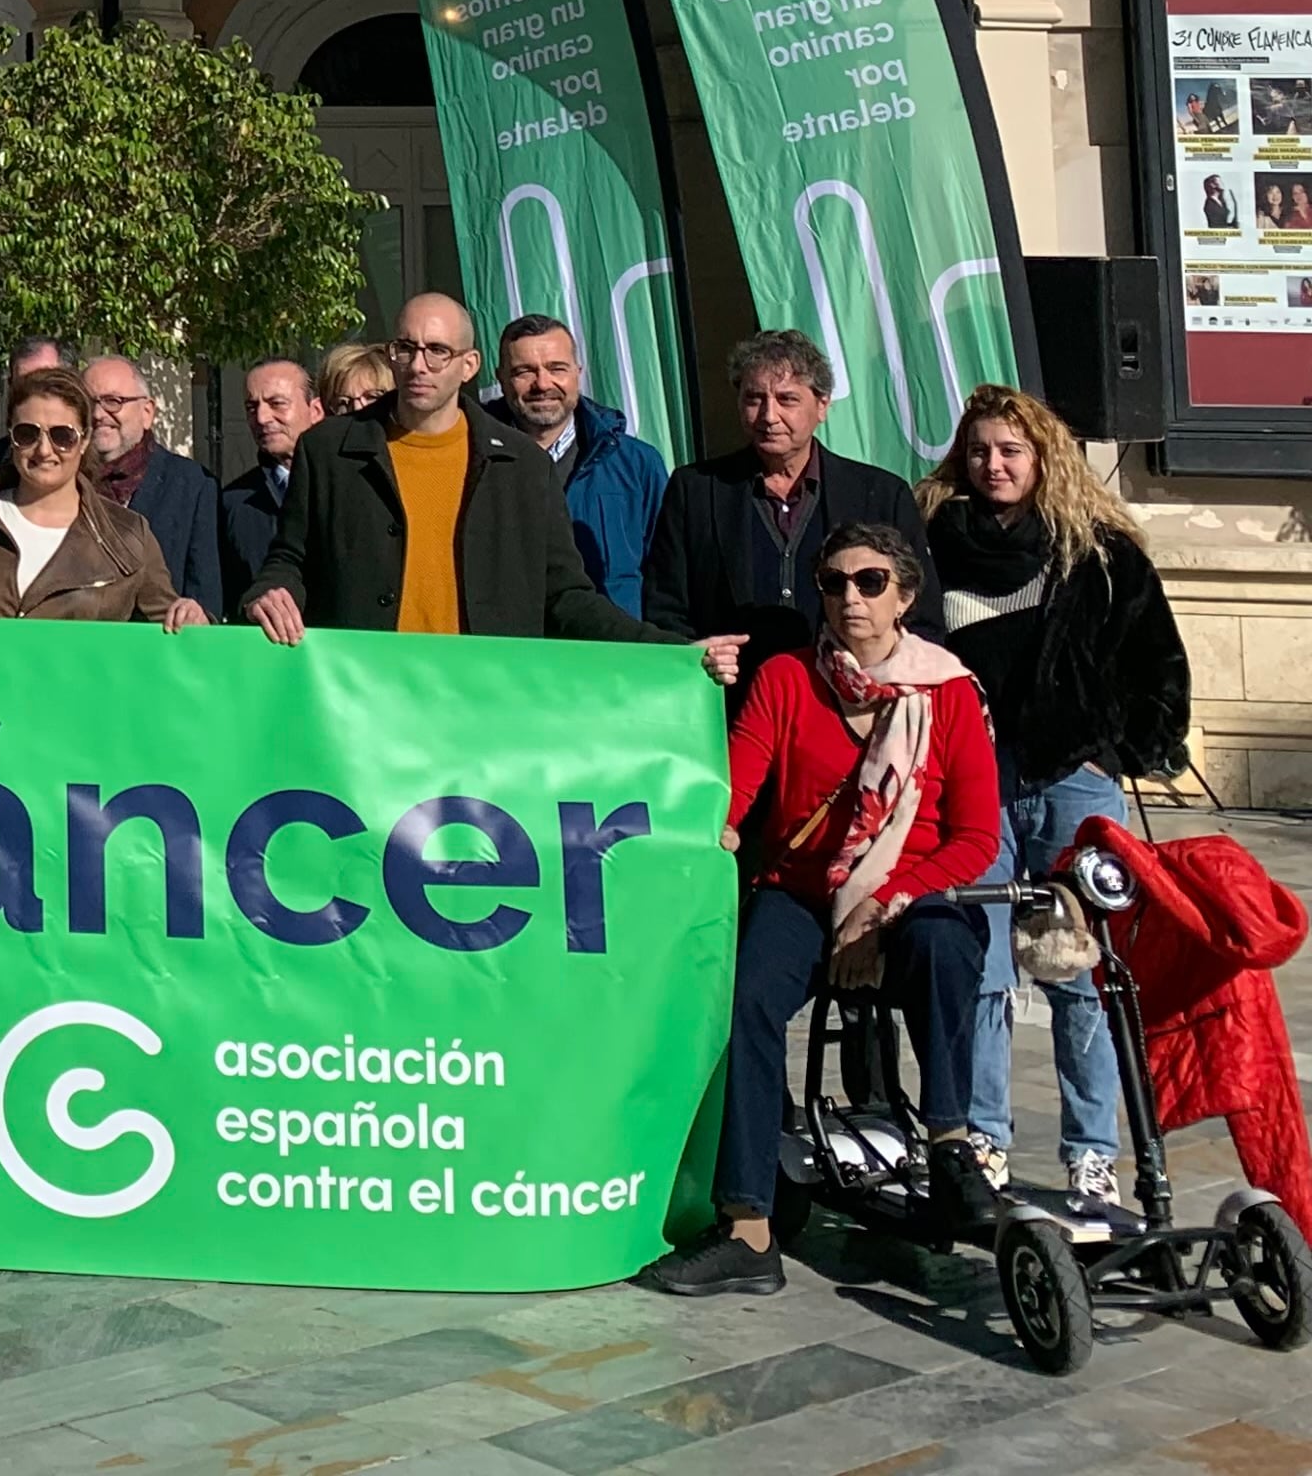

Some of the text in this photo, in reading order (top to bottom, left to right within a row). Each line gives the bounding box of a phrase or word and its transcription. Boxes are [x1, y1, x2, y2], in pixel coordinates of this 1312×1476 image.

[1172, 30, 1192, 47] 31
[1197, 27, 1242, 52] CUMBRE
[214, 1034, 505, 1086] asociación
[215, 1102, 465, 1155] española
[216, 1164, 645, 1217] contra el cáncer
